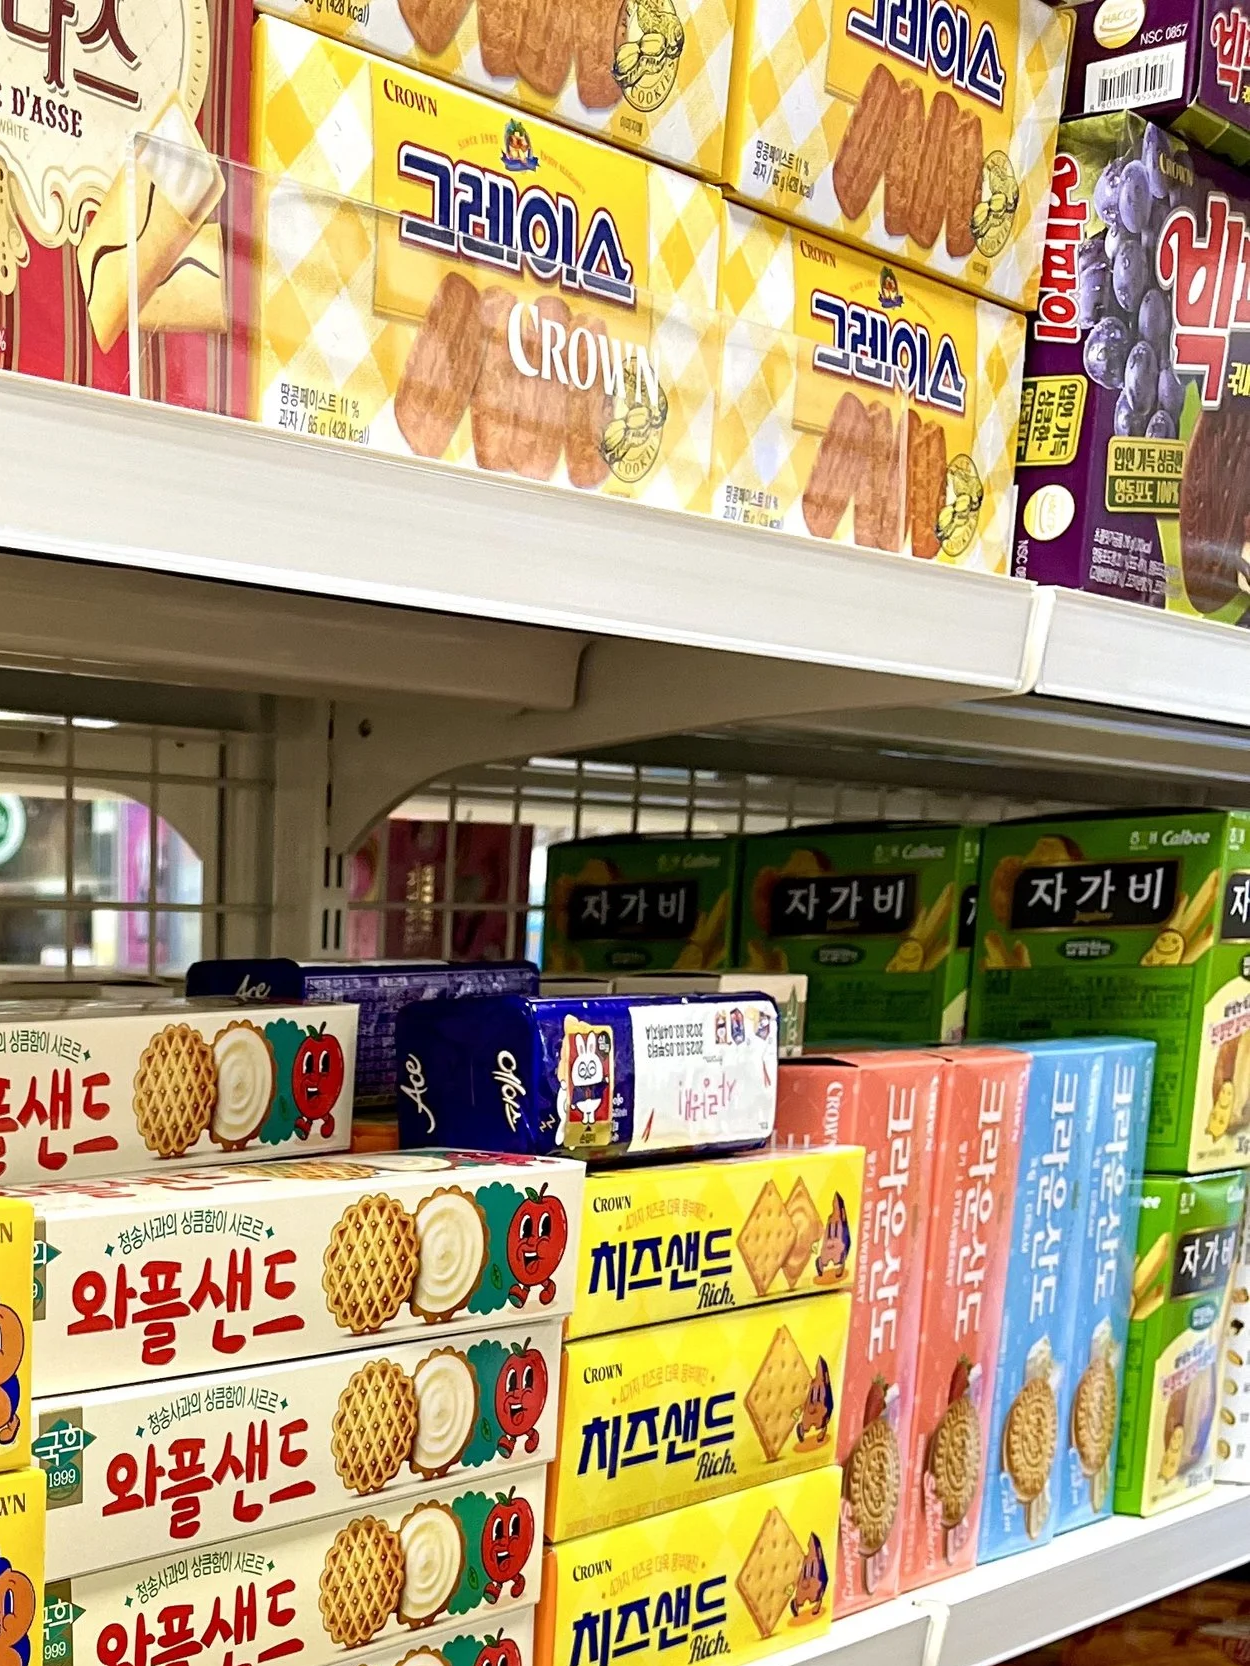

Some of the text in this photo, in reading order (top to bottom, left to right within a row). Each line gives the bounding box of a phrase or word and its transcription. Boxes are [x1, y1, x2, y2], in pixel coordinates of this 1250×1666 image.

[1140, 28, 1164, 46] NSC
[11, 86, 84, 139] D'ASSE
[383, 79, 438, 117] CROWN
[400, 143, 636, 305] 그레이스
[507, 302, 661, 407] CROWN
[812, 290, 967, 414] 그레이스
[278, 409, 298, 431] 과자
[280, 383, 337, 414] 땅콩페이스트
[1161, 829, 1211, 848] Calbee
[786, 877, 907, 923] 자가비
[1026, 864, 1166, 914] 자가비
[9, 1029, 50, 1055] 상큼함이
[51, 1034, 83, 1066] 사르르
[401, 1052, 437, 1133] Ace
[118, 1208, 264, 1254] 청송사과의 상큼함이 사르르
[867, 1083, 917, 1363] 크라운산도
[954, 1077, 1007, 1344] 크라운산도
[587, 1227, 733, 1302] 치즈샌드
[66, 1247, 306, 1366] 와플샌드
[577, 1391, 736, 1481] 치즈샌드
[102, 1418, 316, 1541] 와플샌드
[573, 1559, 613, 1583] CROWN
